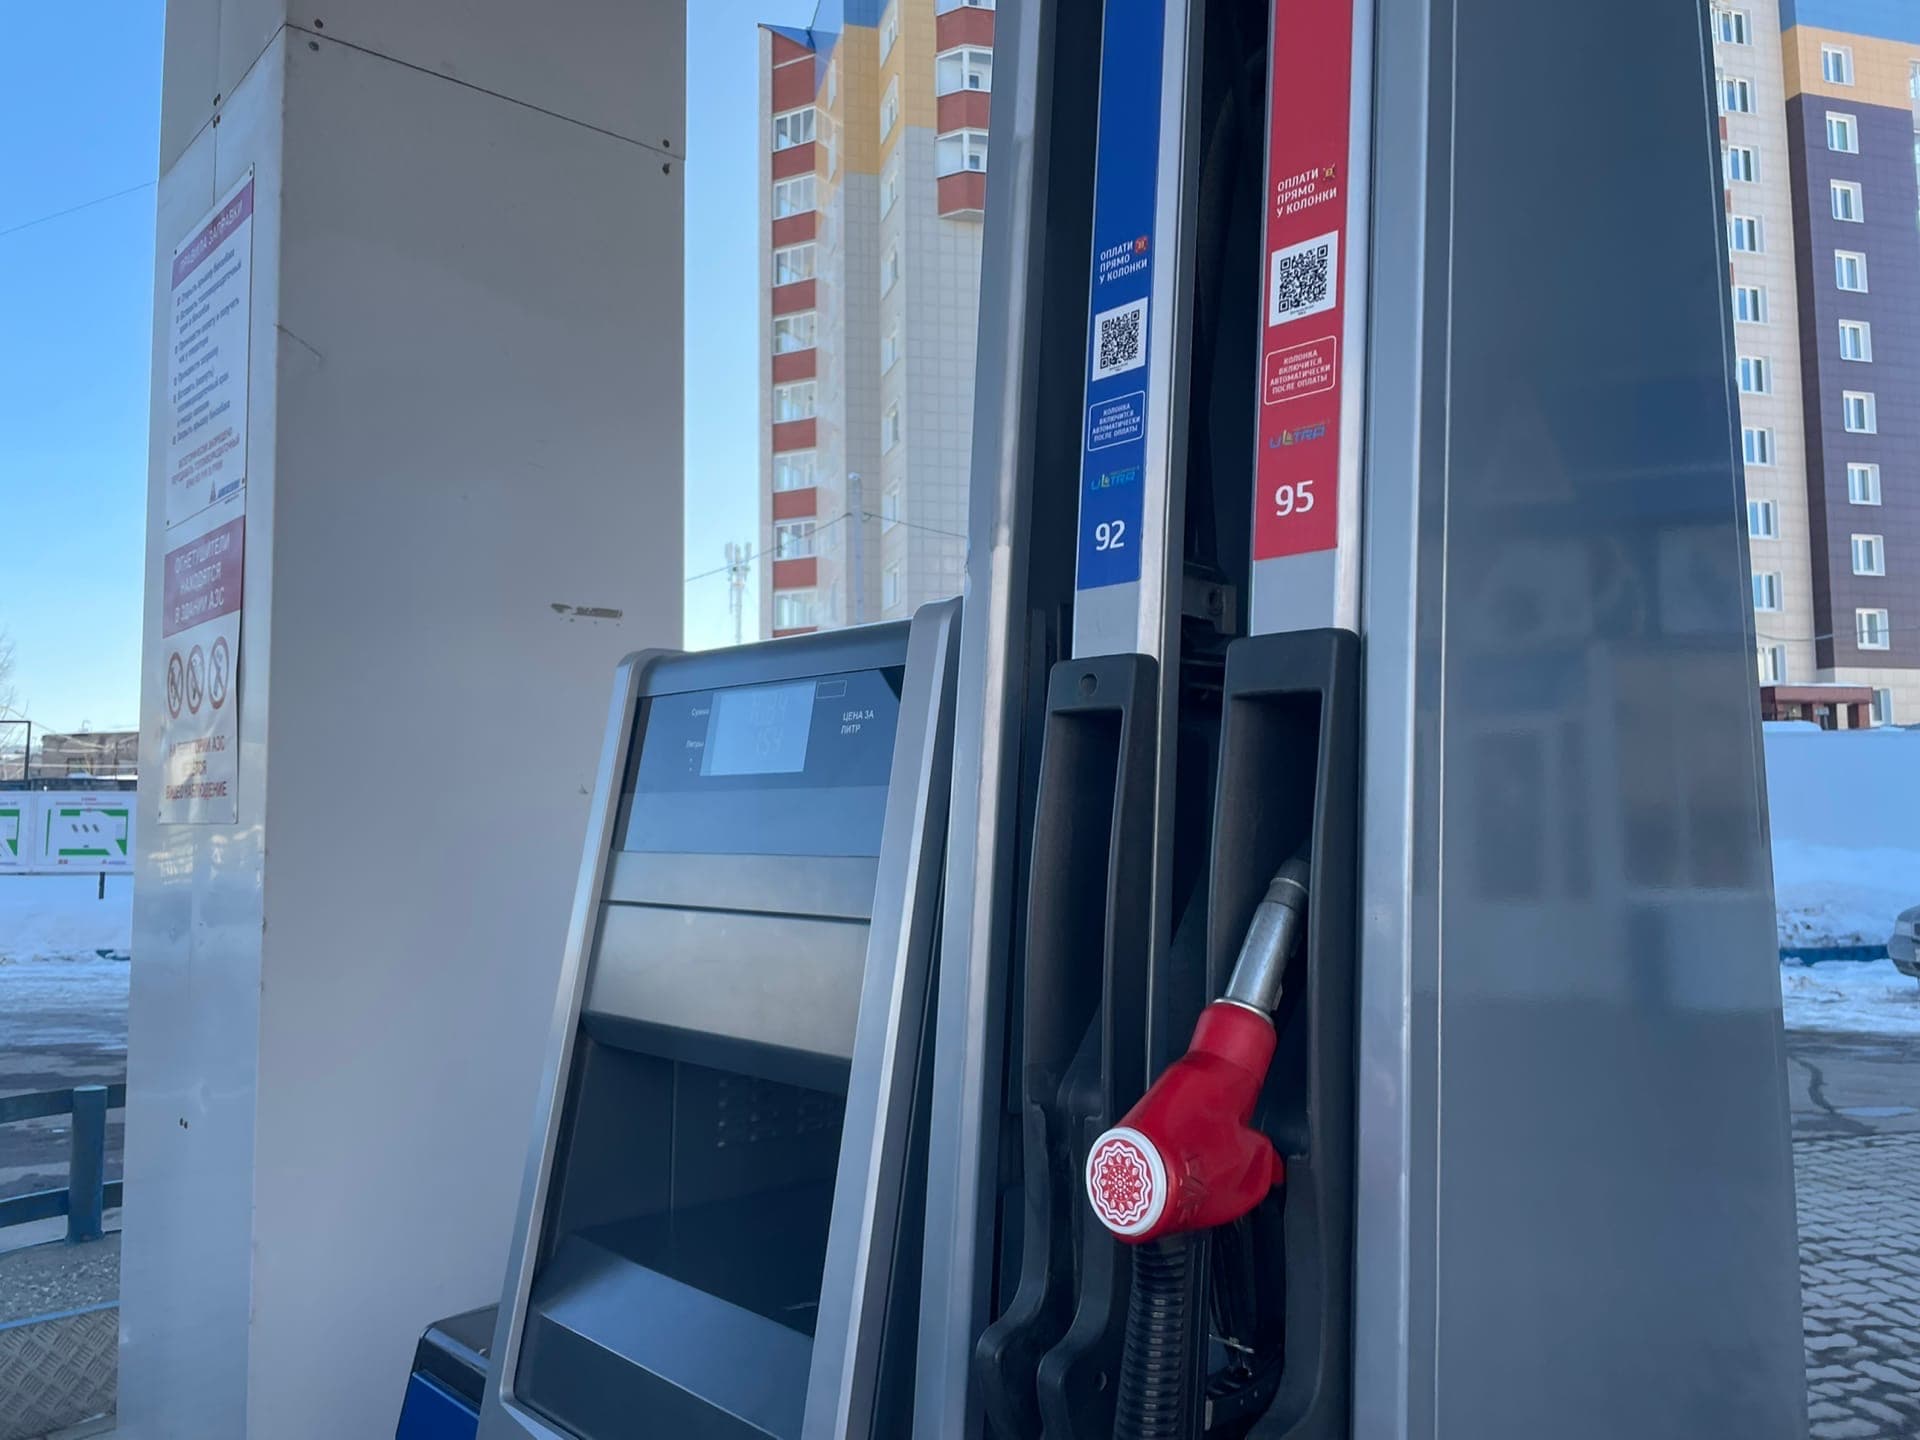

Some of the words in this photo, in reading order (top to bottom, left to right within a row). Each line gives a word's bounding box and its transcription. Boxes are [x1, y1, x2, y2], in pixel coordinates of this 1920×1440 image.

[1277, 168, 1319, 192] ОПЛАТИ
[1276, 206, 1284, 218] У
[1286, 187, 1337, 214] КОЛОНКИ
[1277, 183, 1315, 205] ПРЯМО
[1100, 240, 1133, 261] ОПЛАТИ
[1099, 274, 1105, 285] У
[1107, 258, 1148, 282] КОЛОНКИ
[1100, 253, 1130, 273] ПРЯМО
[1278, 357, 1322, 375] ВКЛЮЧИТСЯ
[1283, 349, 1318, 365] КОЛОНКА
[1270, 364, 1331, 387] АВТОМАТИЧЕСКИ
[1272, 383, 1295, 395] ПОСЛЕ
[1297, 374, 1328, 388] ОПЛАТЫ
[1099, 409, 1134, 425] ВКЛЮЧИТСЯ
[1103, 403, 1131, 417] КОЛОНКА
[1092, 416, 1140, 434] АВТОМАТИЧЕСКИ
[1094, 431, 1112, 442] ПОСЛЕ
[1113, 425, 1138, 437] ОПЛАТЫ
[1275, 480, 1315, 517] 95
[1095, 519, 1125, 551] 92
[208, 586, 225, 609] АЗС
[843, 711, 863, 722] ЦЕНА
[864, 709, 874, 720] ЗА
[840, 724, 861, 735] ЛИТР
